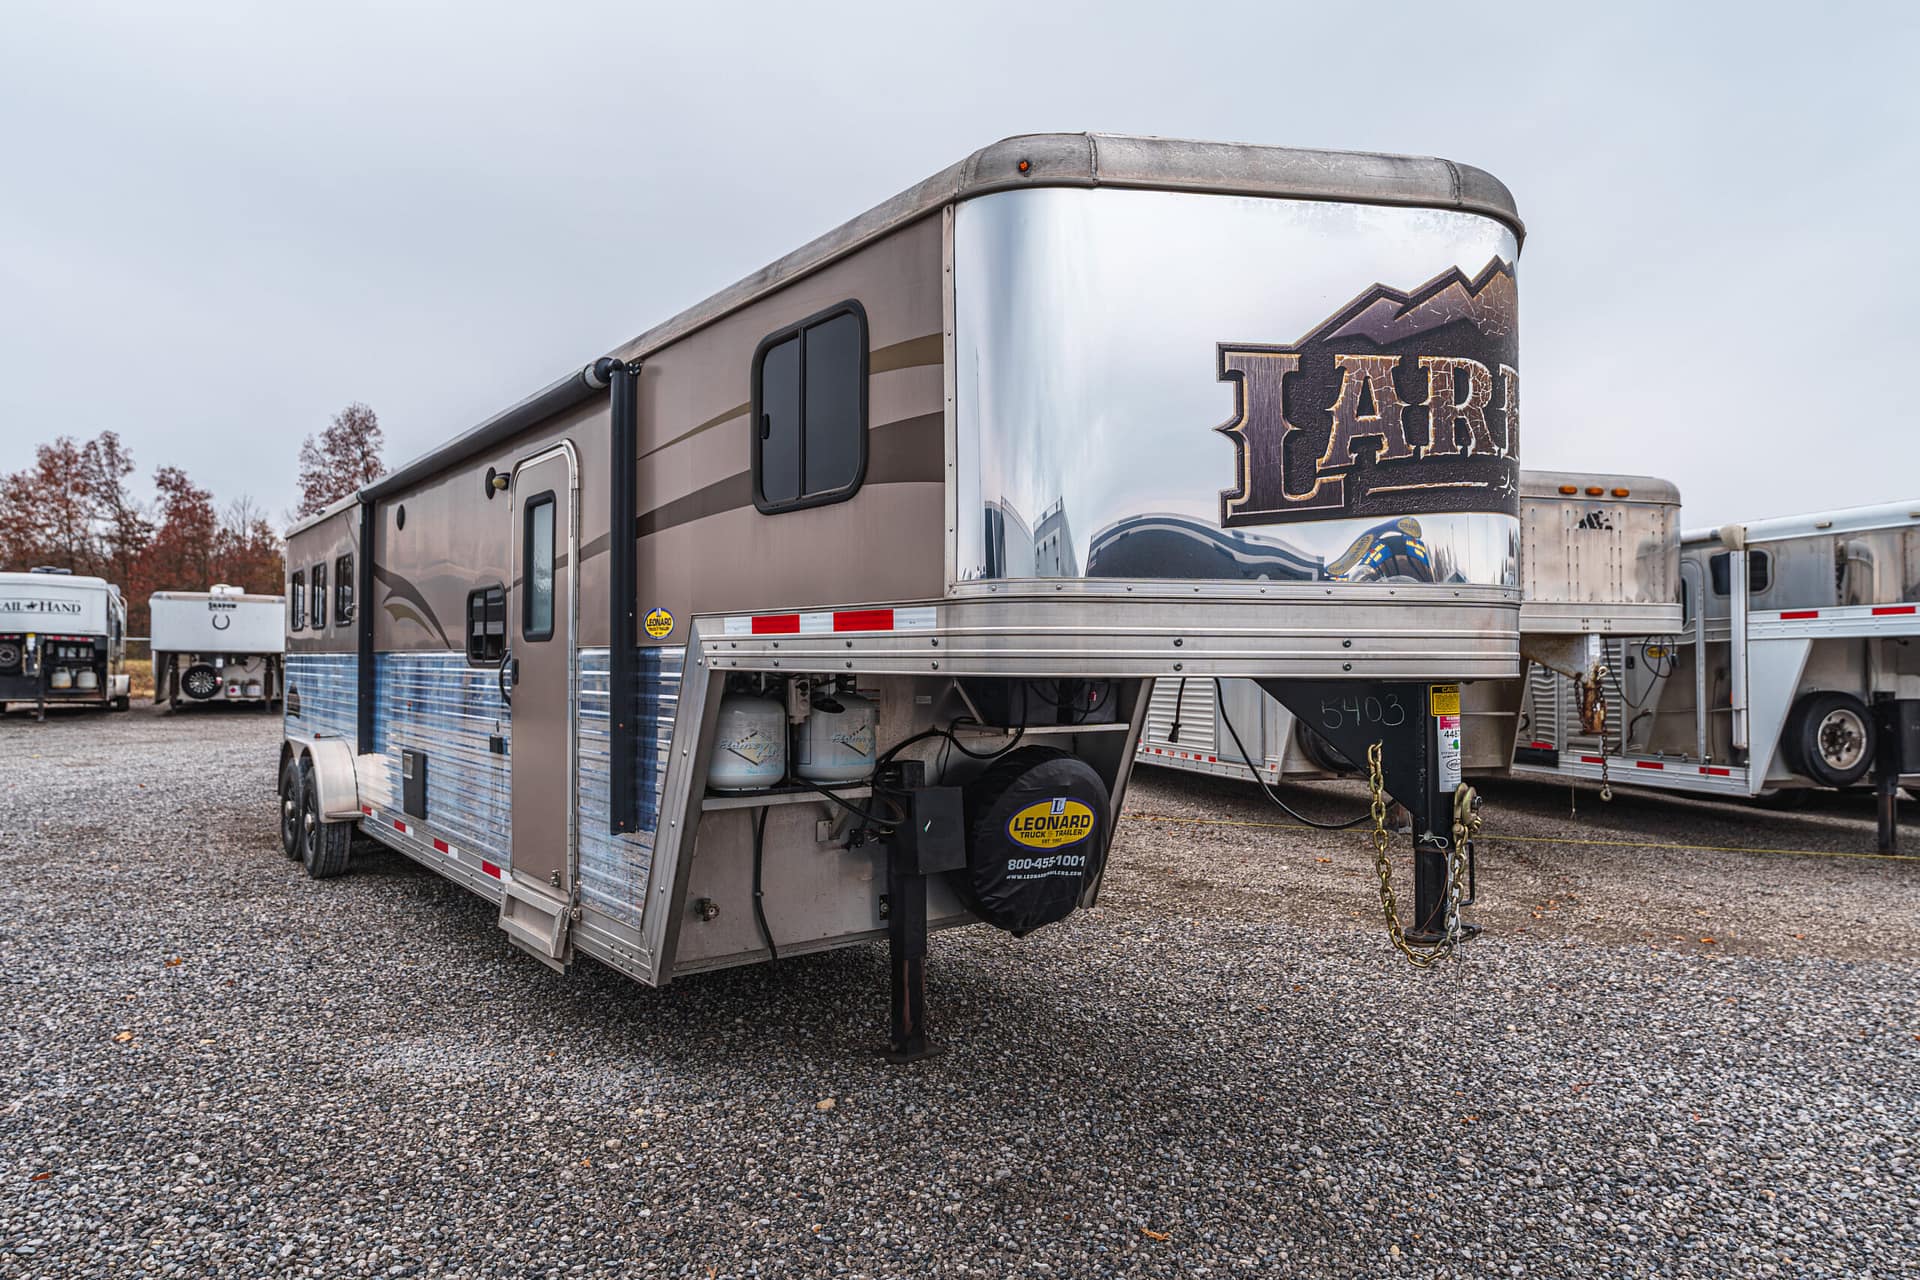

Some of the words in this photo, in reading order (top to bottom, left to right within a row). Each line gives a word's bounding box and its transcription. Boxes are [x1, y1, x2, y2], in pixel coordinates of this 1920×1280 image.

[0, 601, 24, 611] AIL
[40, 601, 81, 613] HAND
[647, 617, 671, 626] LEONARD
[1321, 694, 1405, 729] 5403
[1013, 815, 1091, 831] LEONARD
[1020, 831, 1046, 839] TRUCK
[1055, 828, 1083, 837] TRAILER
[1008, 855, 1085, 870] 800-455-1001
